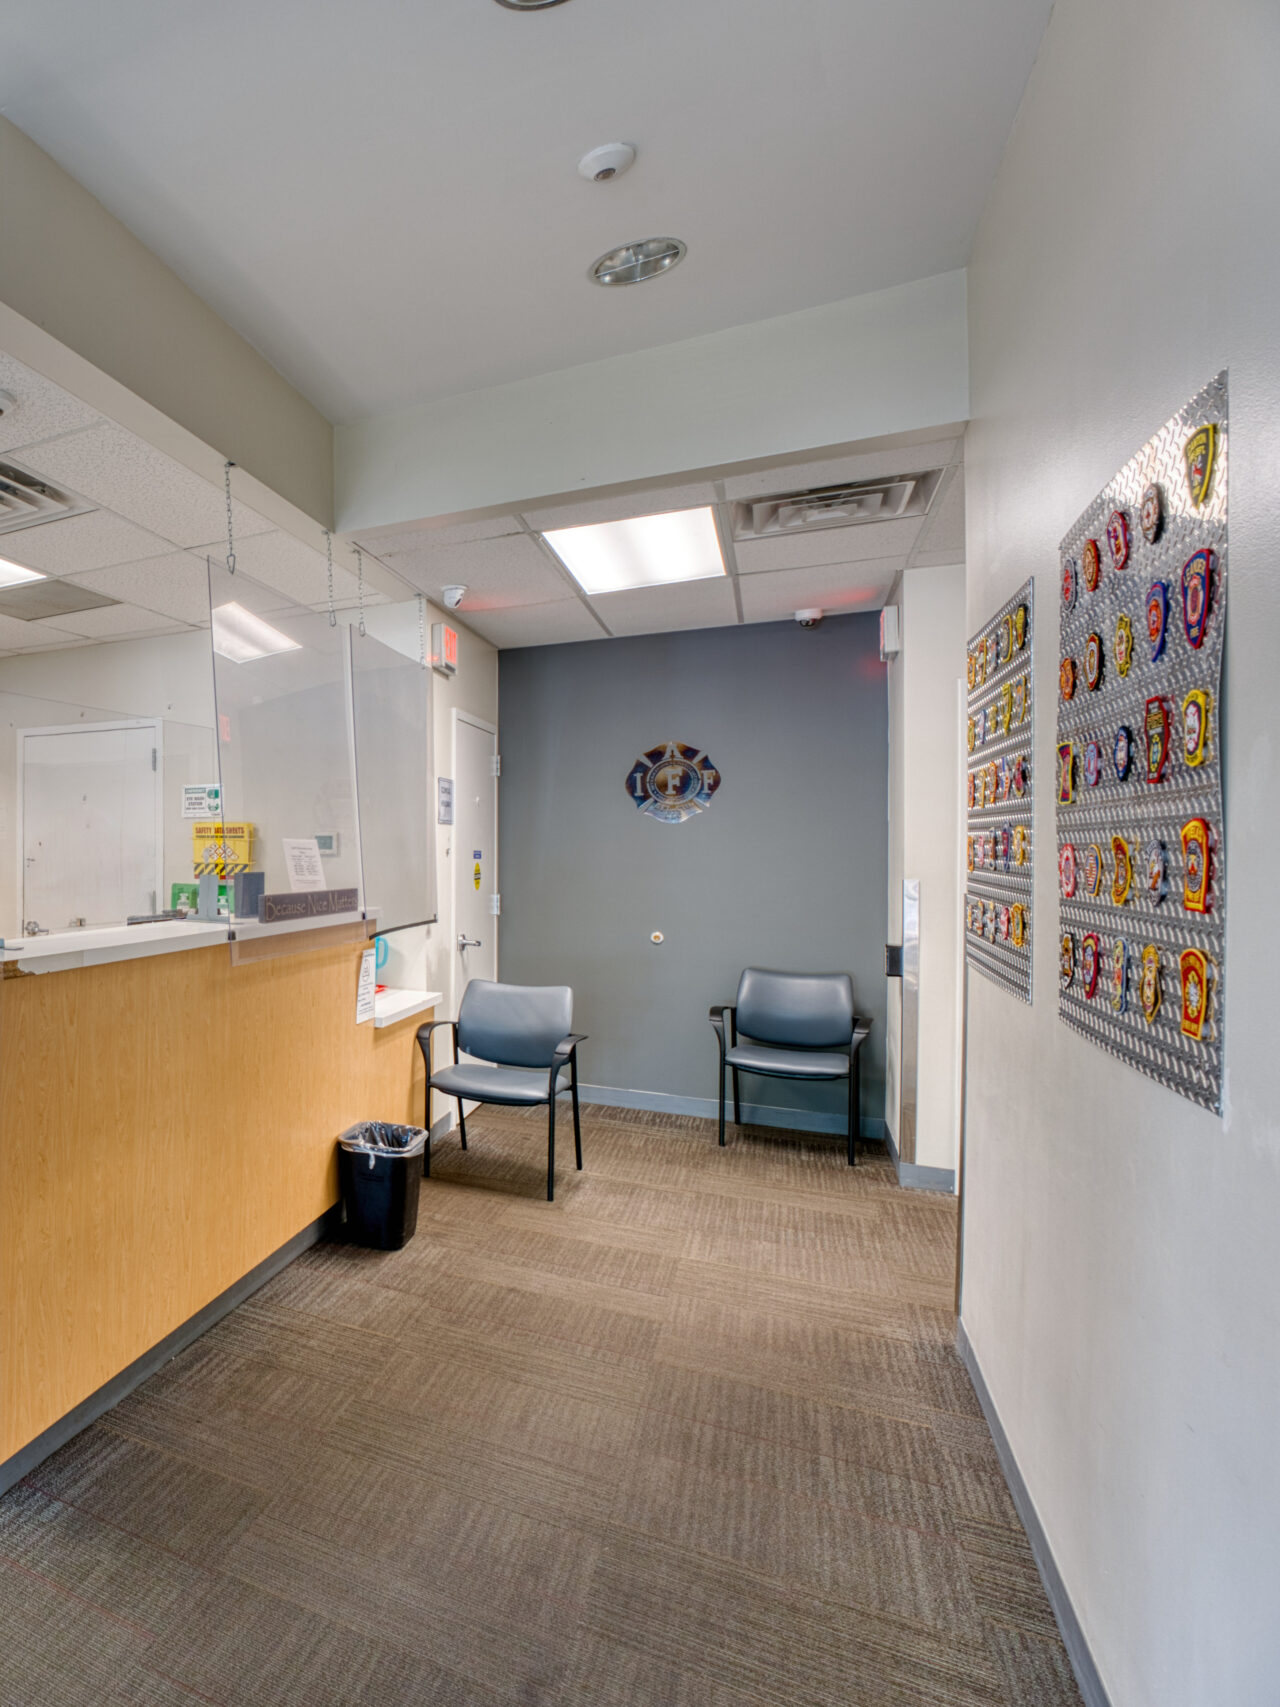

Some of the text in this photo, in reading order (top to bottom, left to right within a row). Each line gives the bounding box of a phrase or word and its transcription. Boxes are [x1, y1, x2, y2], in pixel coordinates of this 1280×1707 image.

[195, 826, 212, 834] SAFETY
[225, 826, 245, 834] SHEETS
[265, 890, 358, 921] Because Nice Matters
